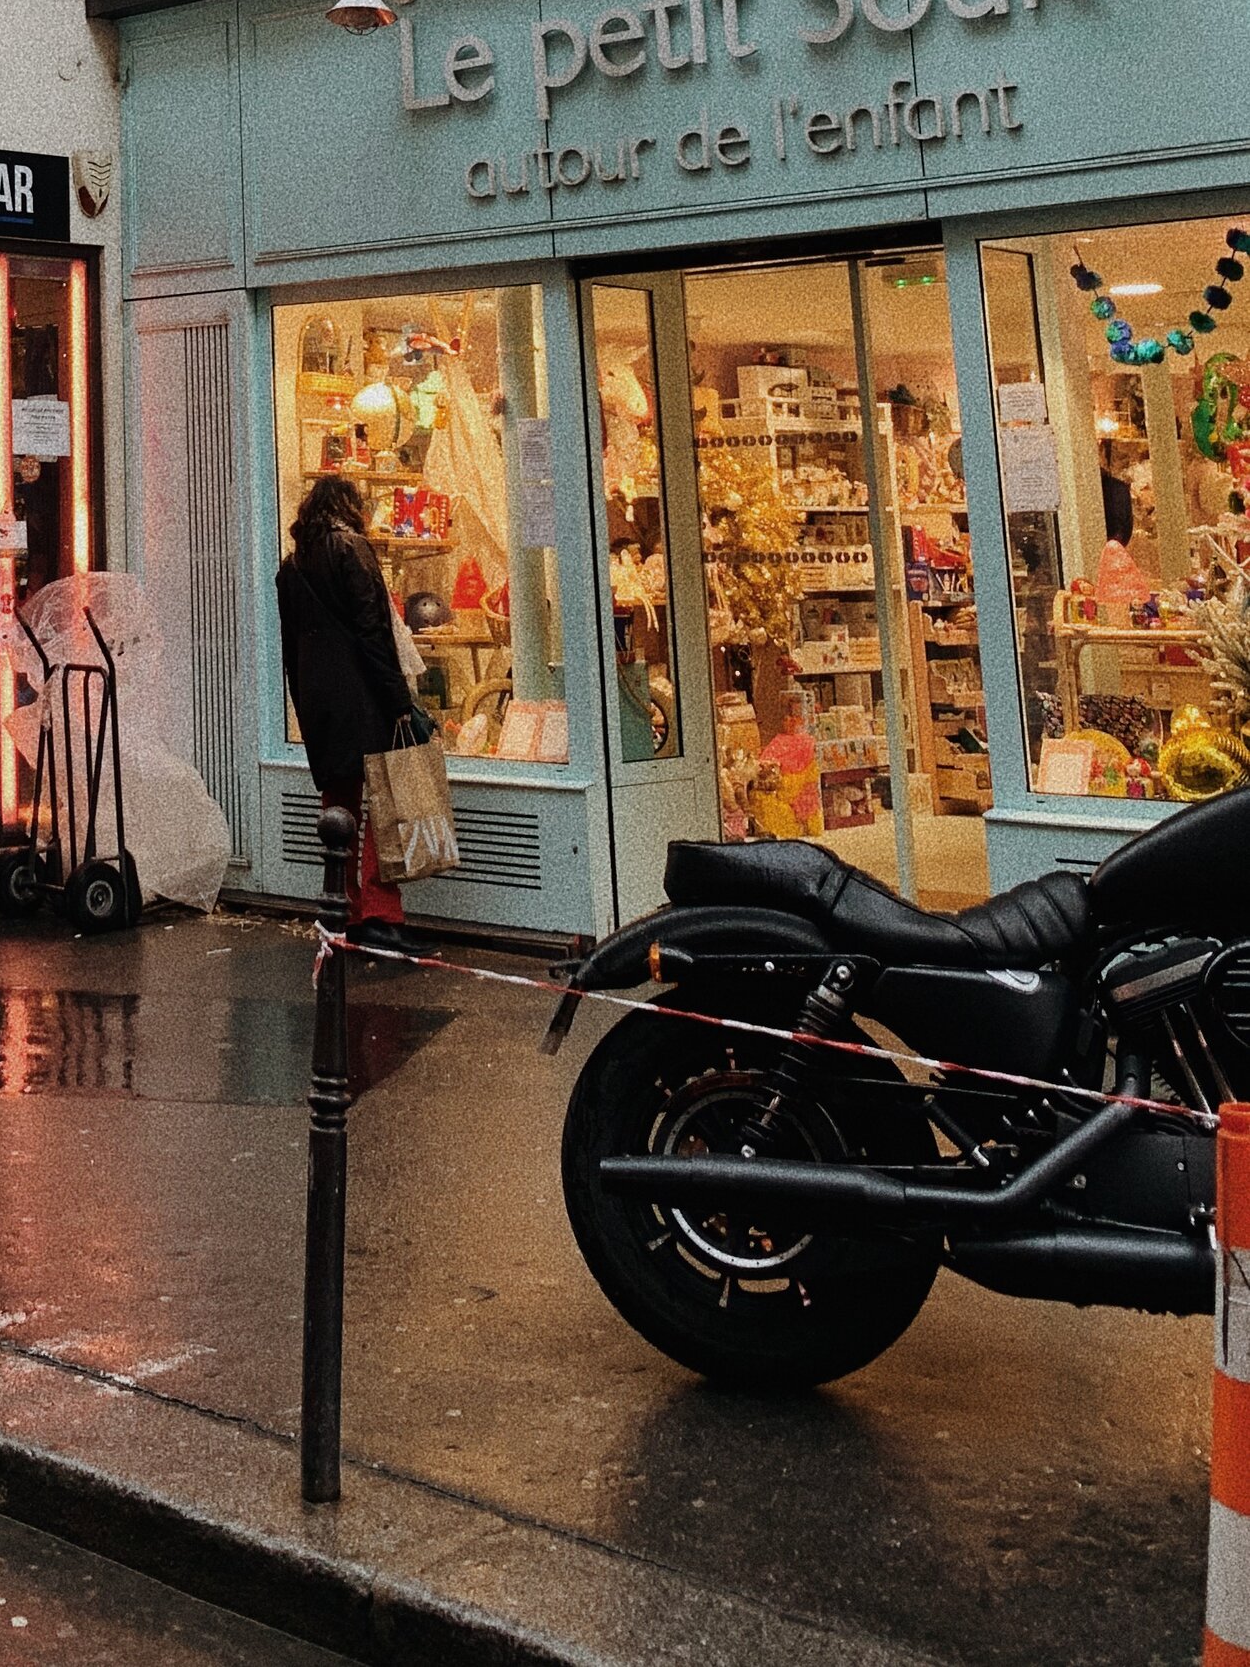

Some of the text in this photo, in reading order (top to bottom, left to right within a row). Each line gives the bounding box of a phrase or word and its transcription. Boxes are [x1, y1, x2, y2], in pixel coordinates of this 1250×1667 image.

[399, 14, 494, 110] Le
[465, 69, 1024, 199] autour de l'enfant
